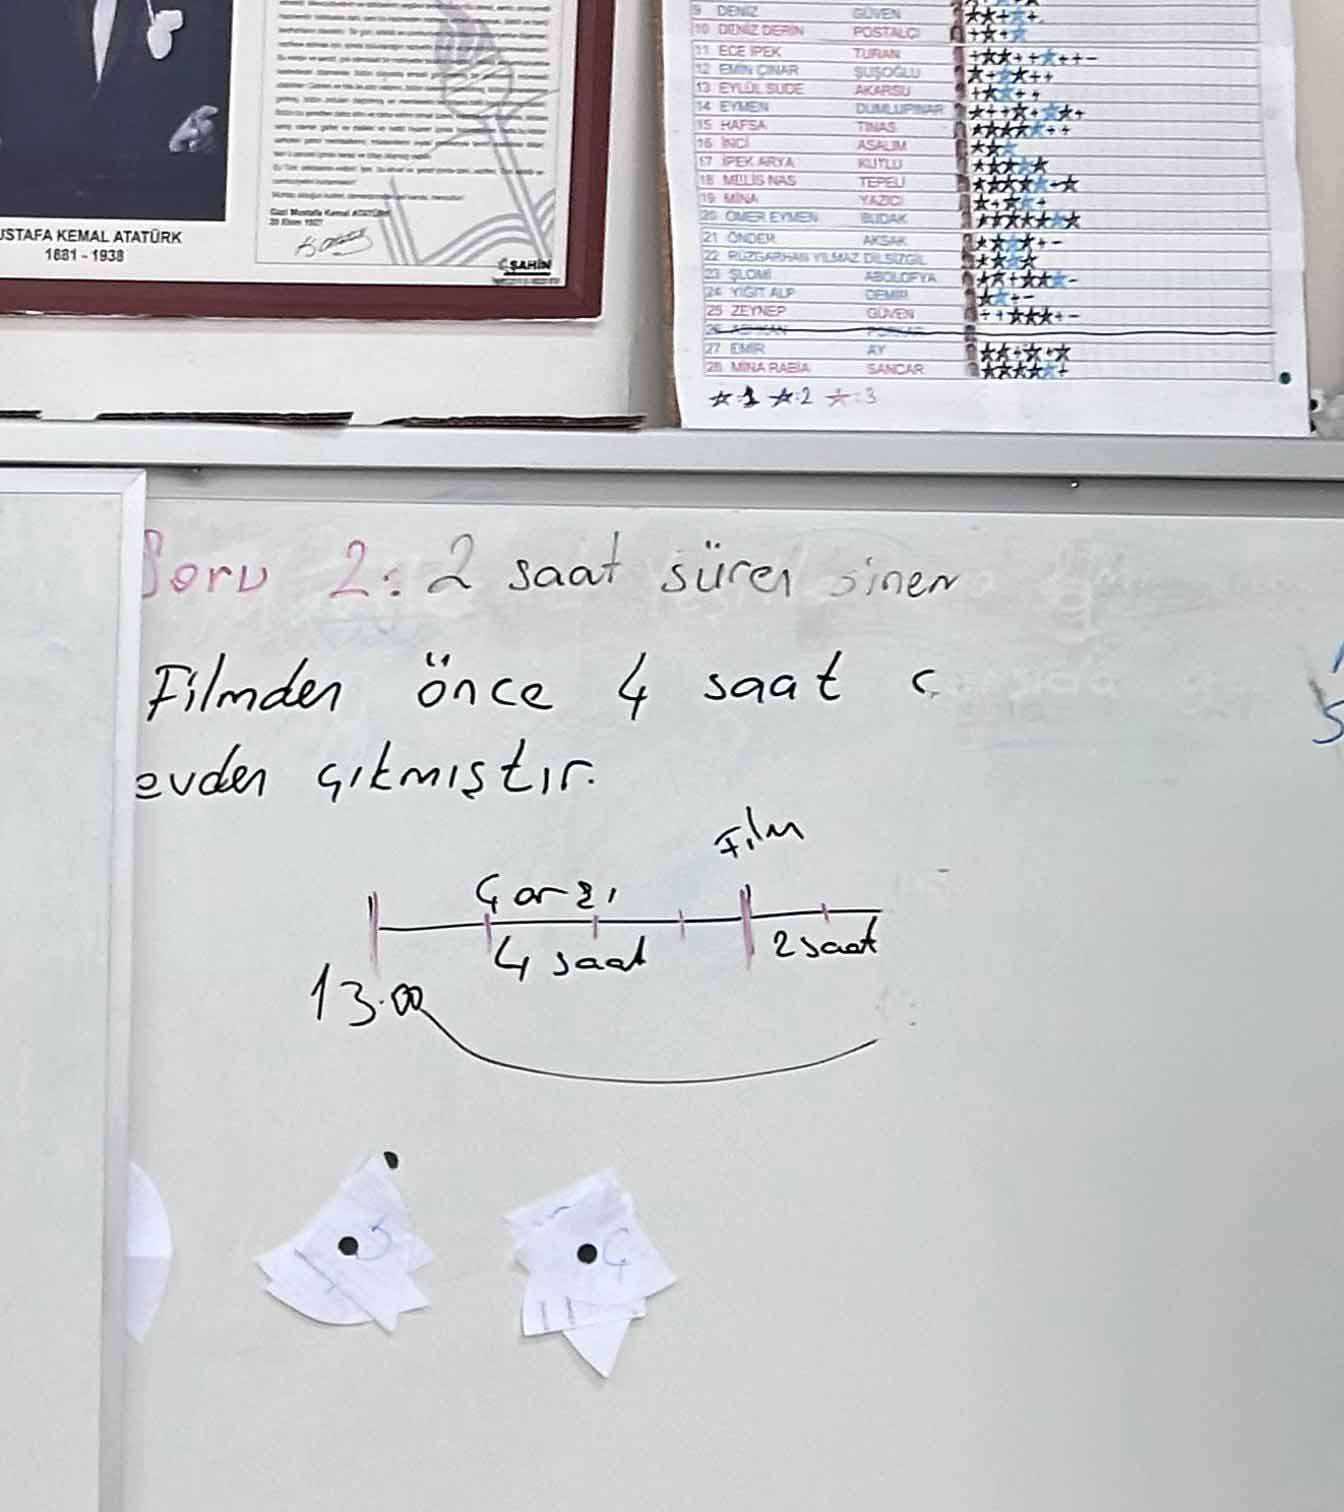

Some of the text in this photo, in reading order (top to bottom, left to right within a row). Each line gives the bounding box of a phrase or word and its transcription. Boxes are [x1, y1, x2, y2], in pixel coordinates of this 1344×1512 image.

[57, 229, 110, 243] KEMAL
[113, 228, 183, 244] ATATÜRK
[92, 249, 125, 263] 1938
[866, 344, 887, 357] AY
[426, 533, 475, 595] 2
[508, 530, 623, 593] saat
[147, 650, 843, 722] Filmden önce 4 saat
[135, 738, 595, 803] evden çıkmıştır.
[714, 806, 805, 859] Film
[494, 935, 647, 982] 4 saat
[311, 962, 424, 1027] 13.00
